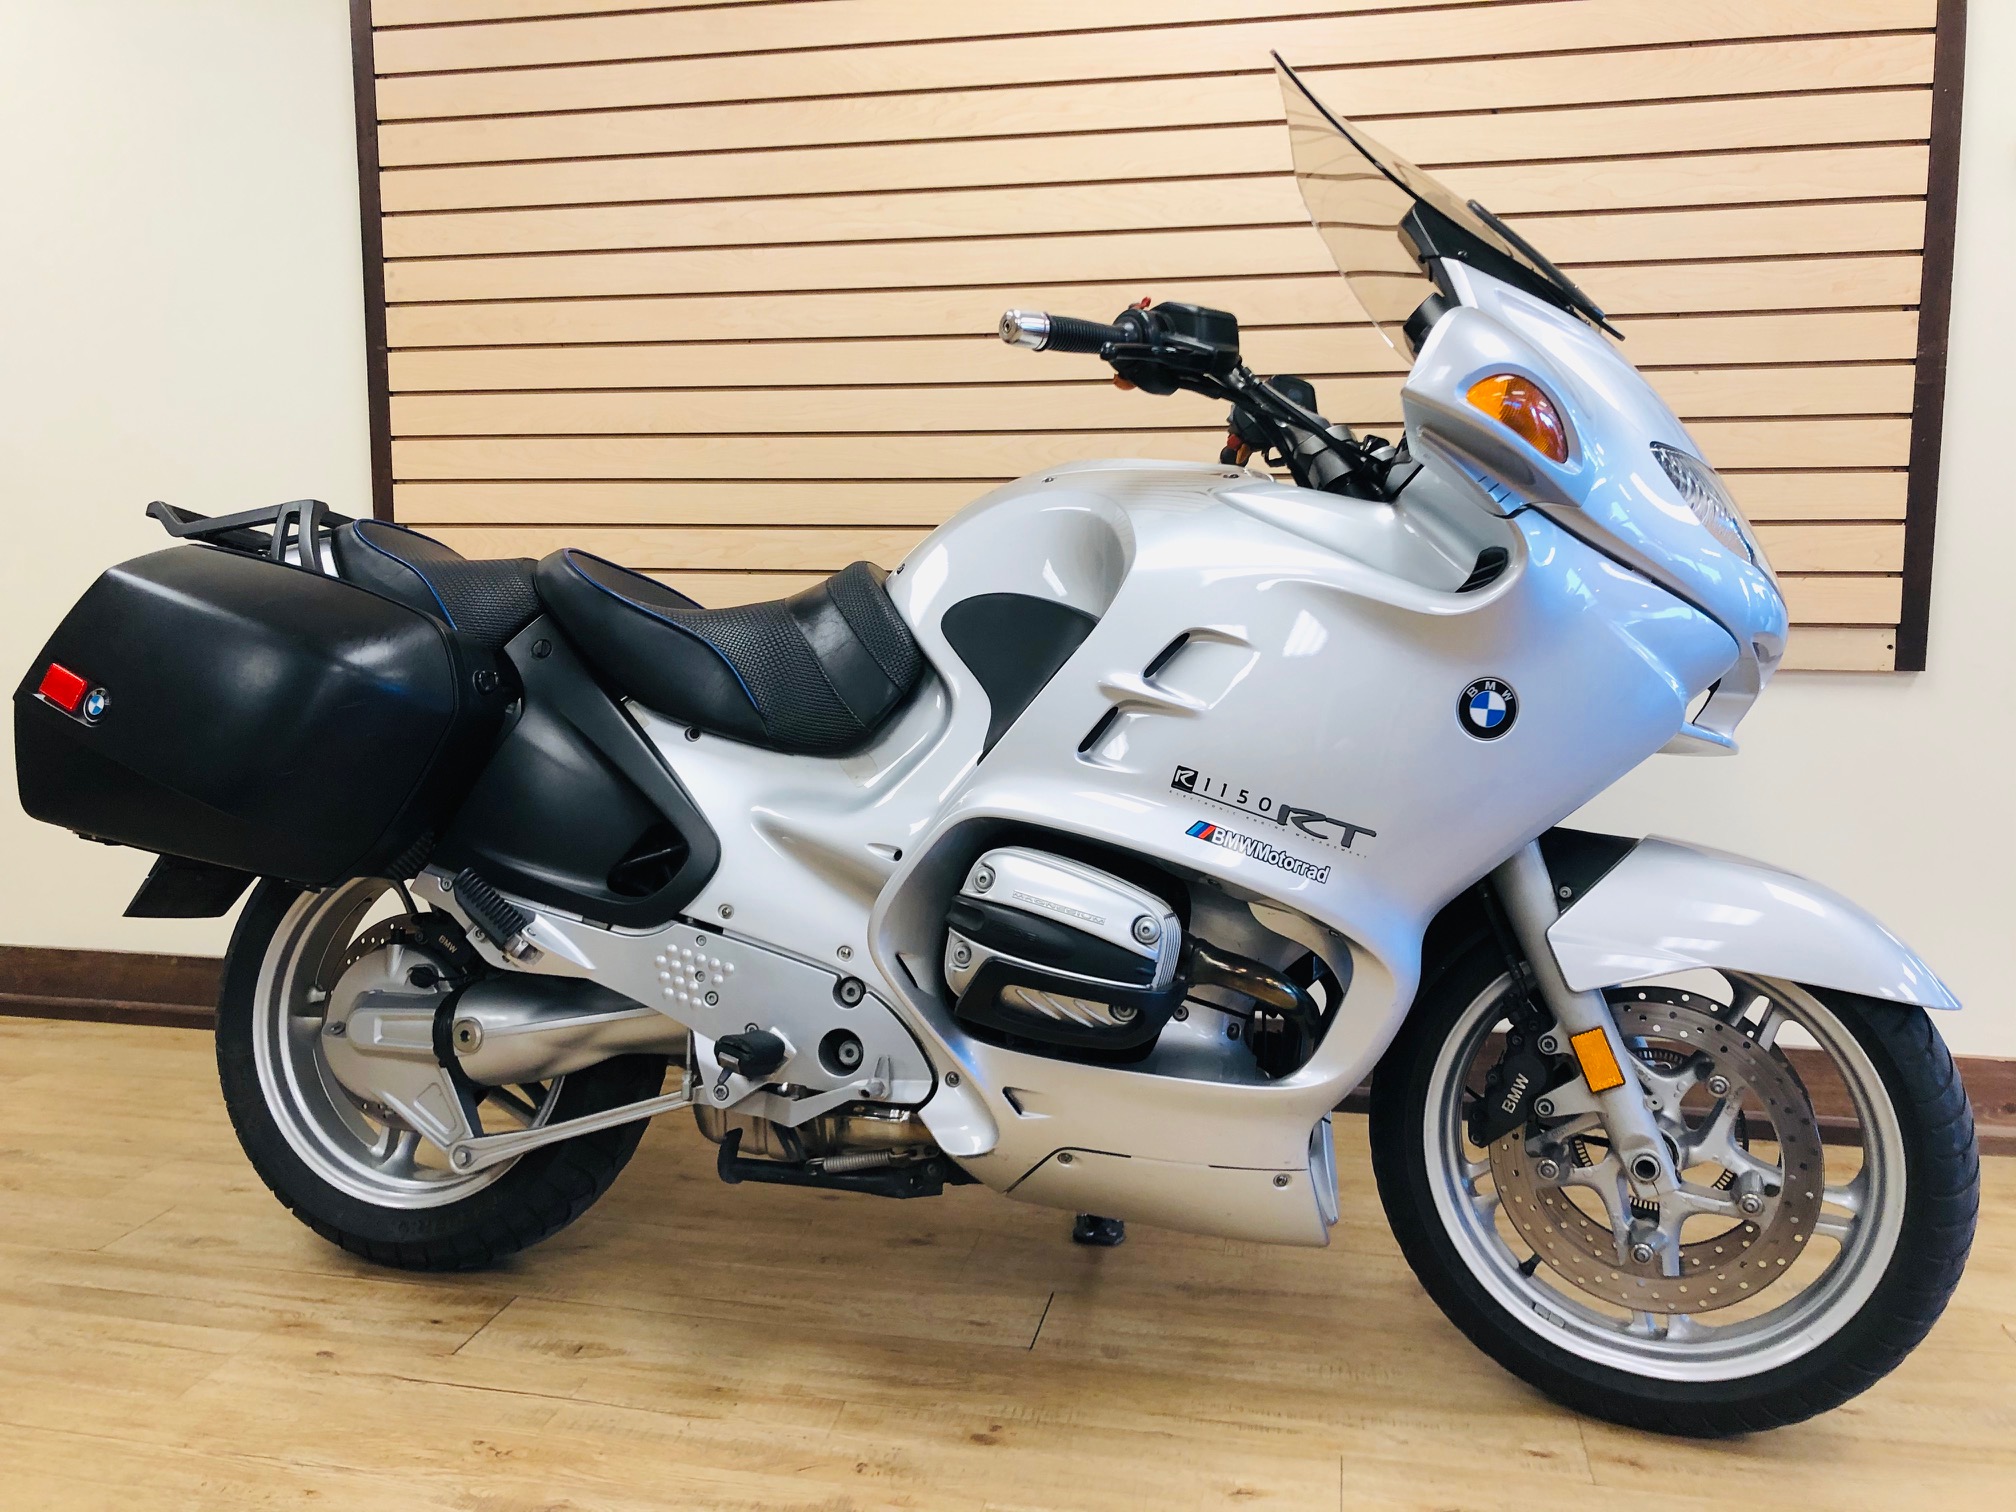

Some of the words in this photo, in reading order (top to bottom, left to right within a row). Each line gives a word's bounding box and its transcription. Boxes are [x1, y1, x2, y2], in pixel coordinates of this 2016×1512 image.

[1466, 681, 1513, 701] BMW
[1173, 767, 1195, 789] R
[1203, 777, 1273, 812] 1150
[1276, 804, 1377, 849] RT
[438, 934, 458, 954] BMW
[1501, 1072, 1529, 1114] BMW
